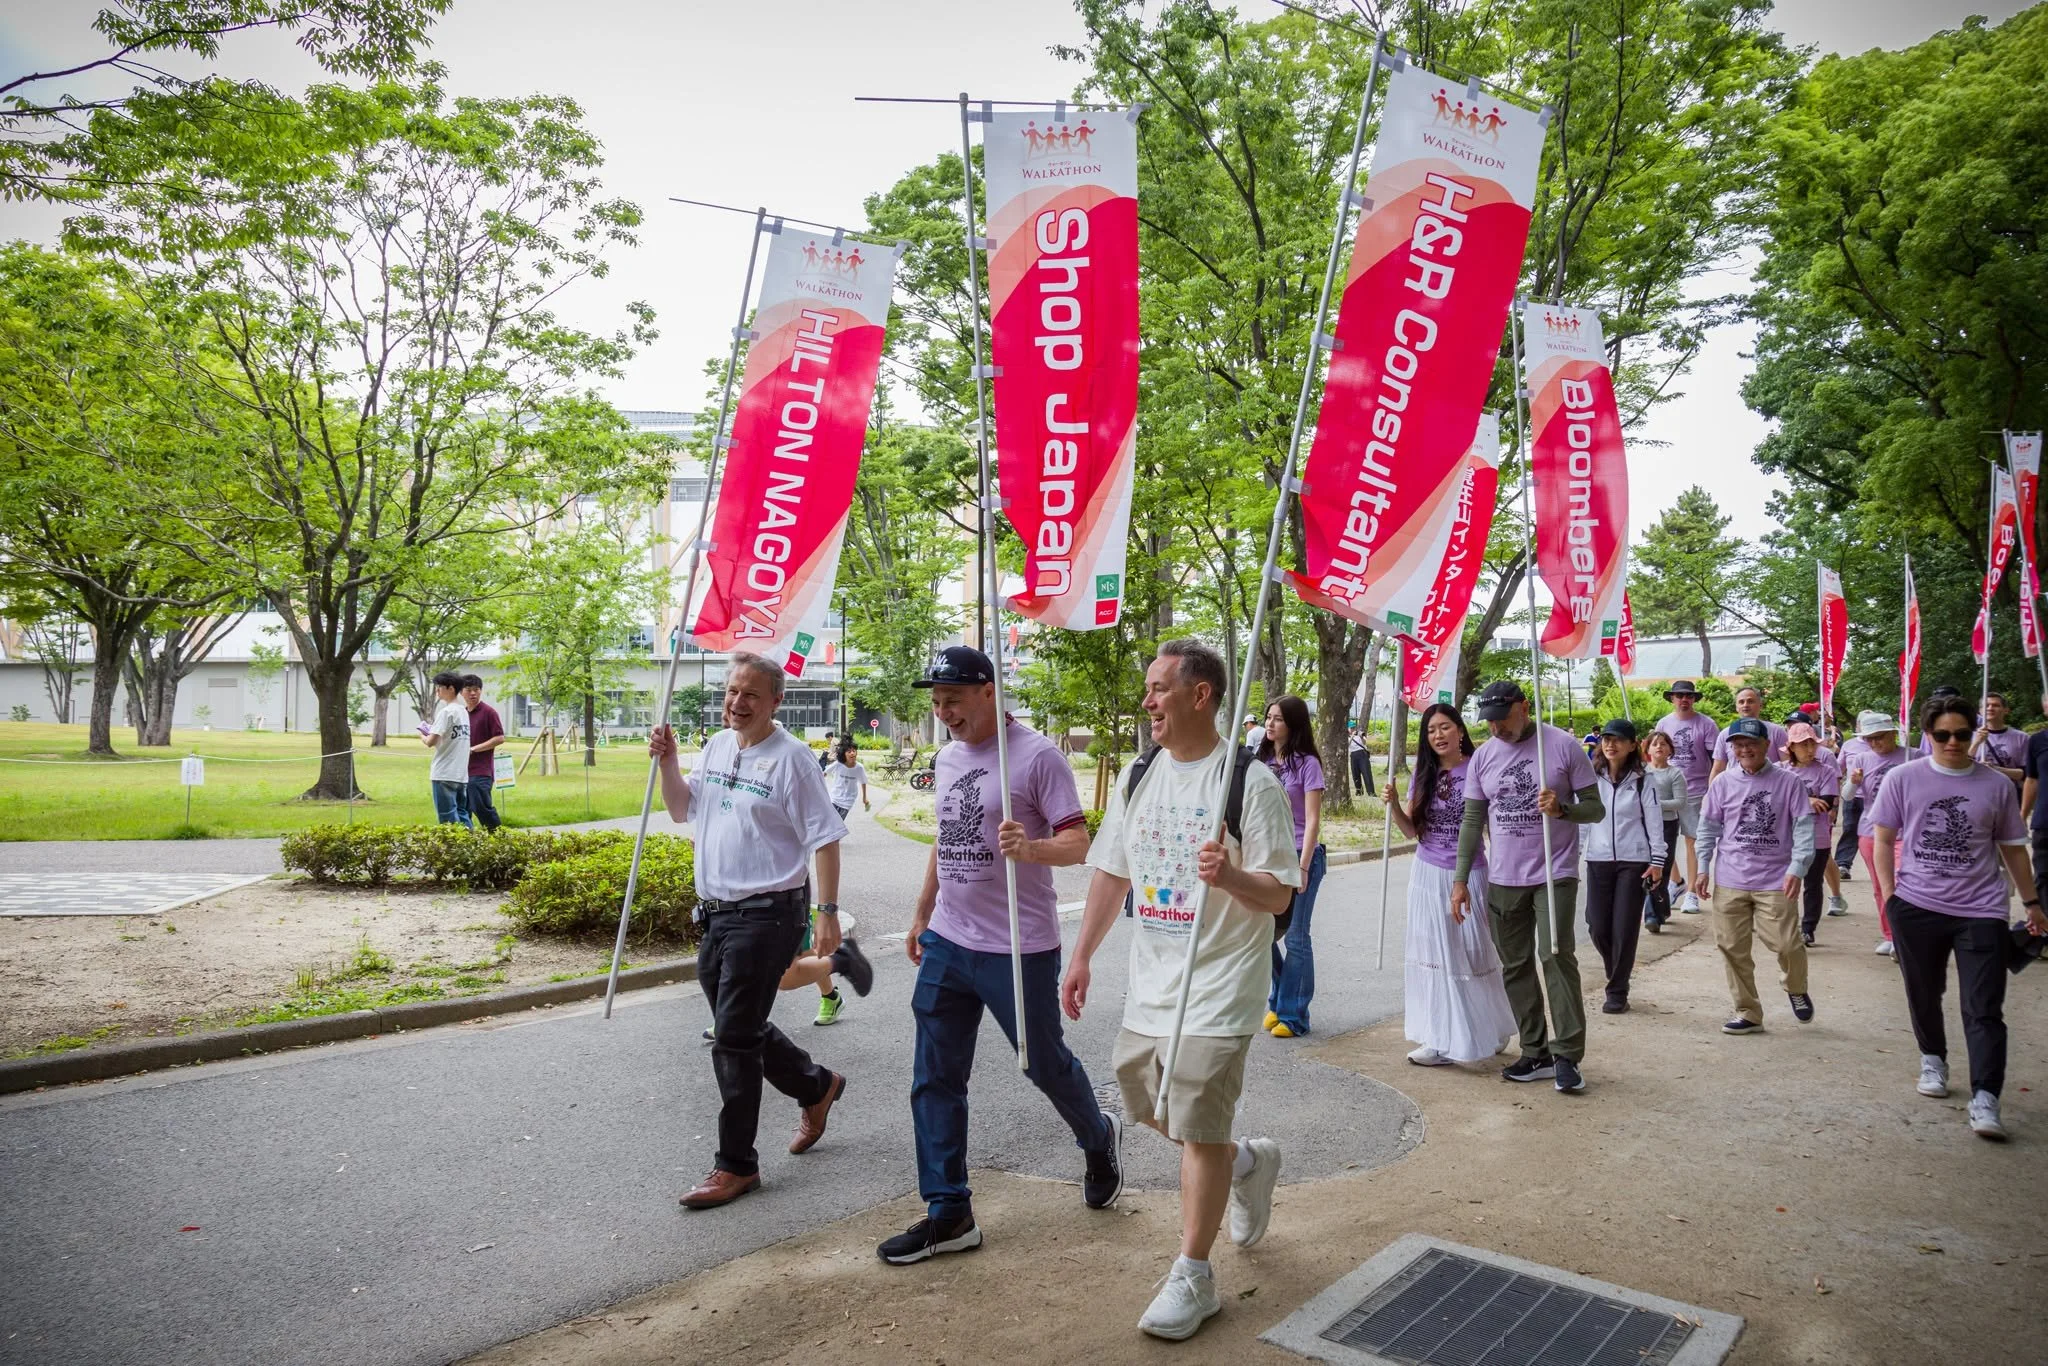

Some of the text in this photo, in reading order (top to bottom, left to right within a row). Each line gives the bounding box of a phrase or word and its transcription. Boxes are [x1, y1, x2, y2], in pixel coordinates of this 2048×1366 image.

[1423, 133, 1506, 170] WALKATHON
[1022, 164, 1102, 179] WALKATHON
[1403, 172, 1476, 300] H&R
[795, 280, 864, 301] WALKATHON
[1546, 342, 1587, 353] WALKATHON
[1034, 206, 1090, 598] Shop Japan
[733, 308, 840, 640] HILTON NAGOYA
[745, 786, 770, 798] IMPACT
[753, 779, 774, 791] School
[1496, 813, 1543, 822] Walkathon
